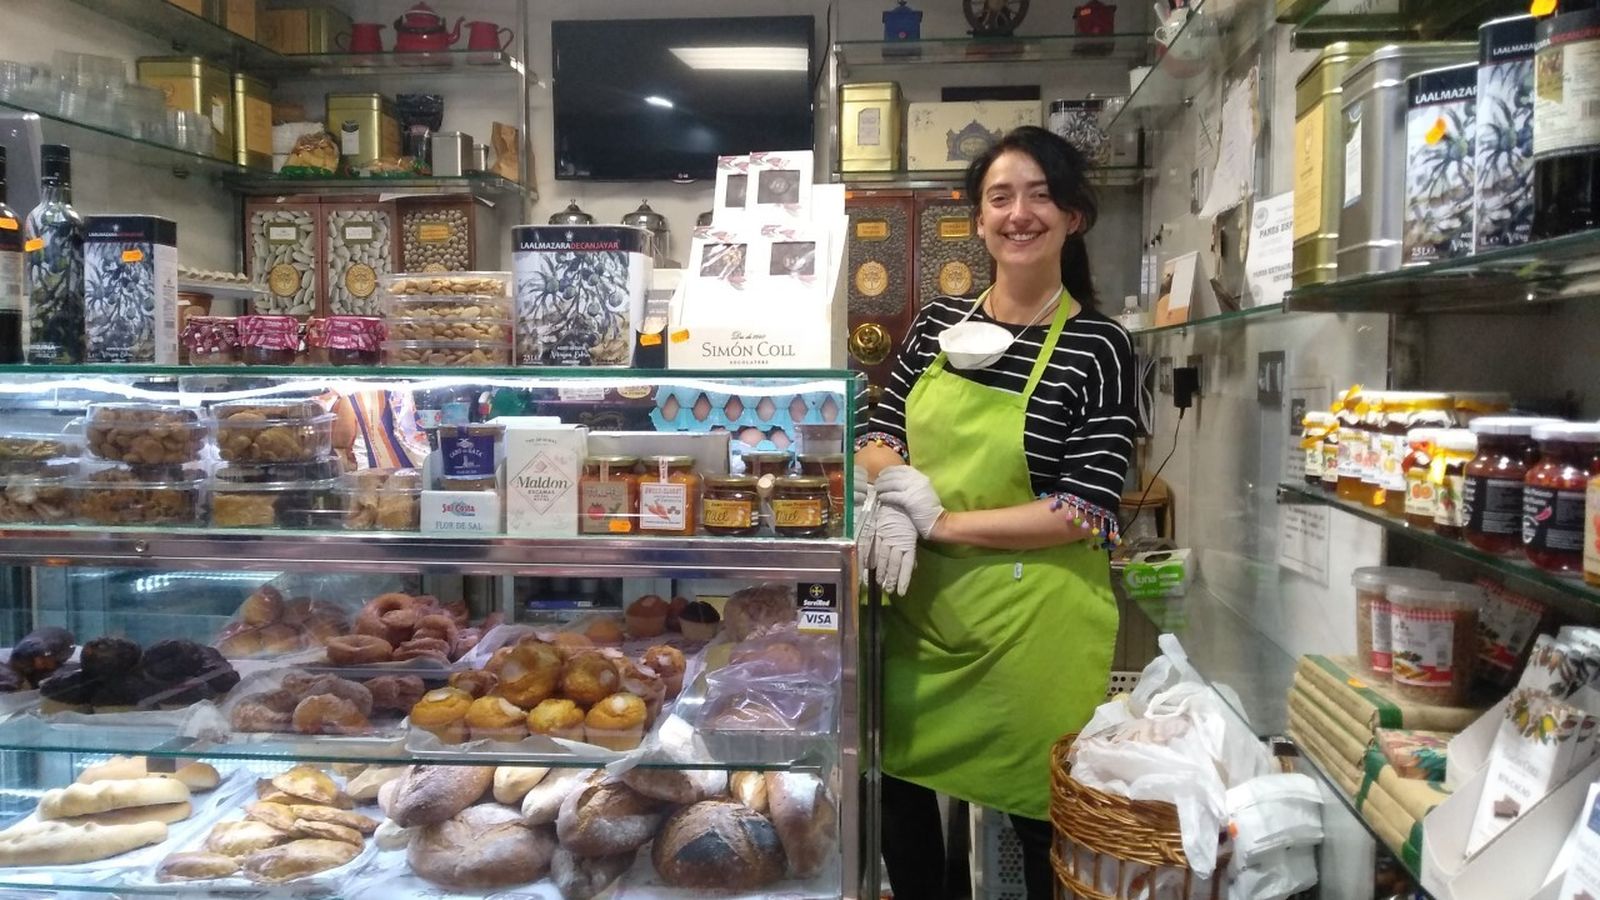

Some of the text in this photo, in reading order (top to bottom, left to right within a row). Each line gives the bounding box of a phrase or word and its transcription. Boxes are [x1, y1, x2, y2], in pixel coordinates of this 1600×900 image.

[516, 476, 568, 489] Maldon
[456, 521, 466, 530] DE
[468, 521, 483, 531] SAL
[807, 614, 831, 624] VISA
